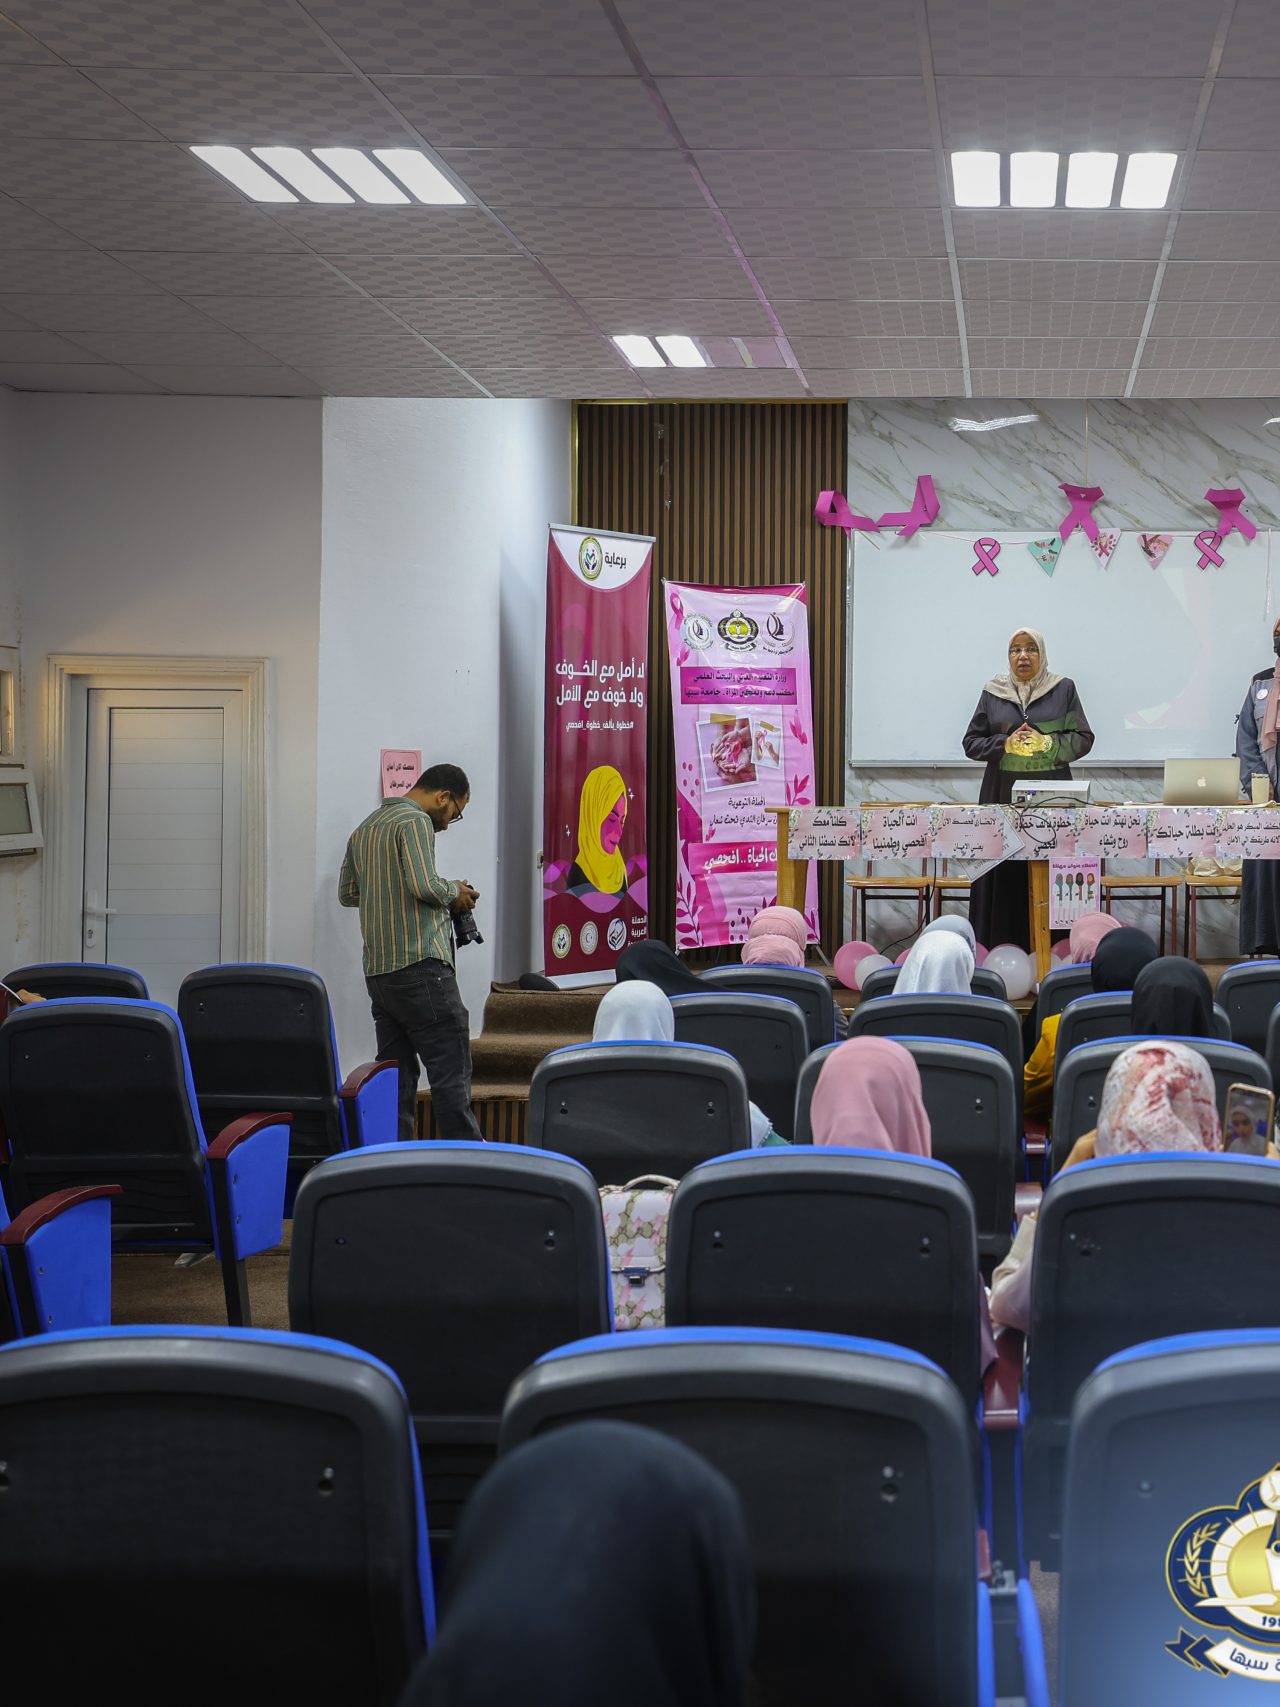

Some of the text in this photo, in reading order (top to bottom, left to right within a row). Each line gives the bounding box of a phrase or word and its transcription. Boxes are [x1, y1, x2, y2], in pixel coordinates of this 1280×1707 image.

[604, 551, 627, 569] برعاية
[599, 664, 615, 683] مع
[616, 657, 635, 682] أمل
[637, 662, 645, 678] لا
[583, 689, 600, 709] مع
[602, 686, 627, 708] خوف
[629, 686, 644, 708] ولا
[1127, 815, 1141, 829] نحن
